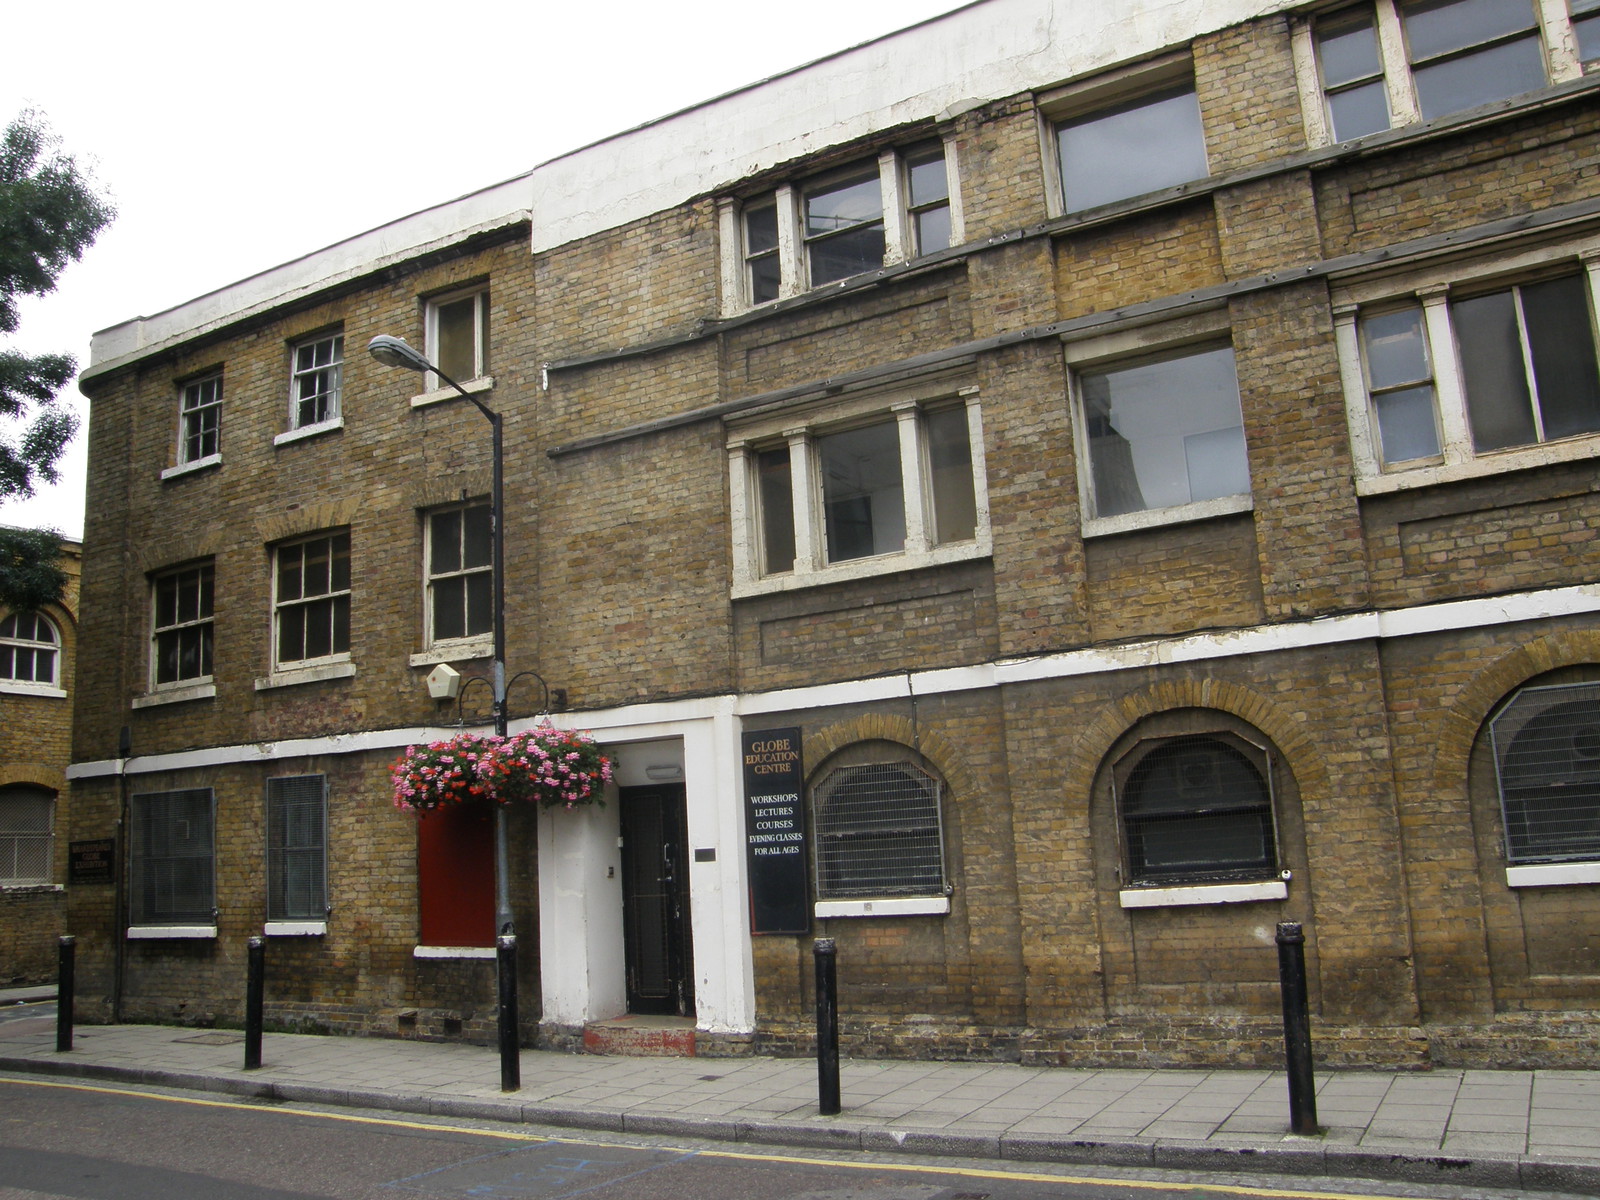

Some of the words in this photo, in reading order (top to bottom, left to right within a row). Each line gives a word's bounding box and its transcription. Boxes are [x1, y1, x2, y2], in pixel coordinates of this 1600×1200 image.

[752, 739, 790, 753] GLOBE
[746, 751, 798, 764] EDUCATION
[754, 763, 791, 774] CENTRE
[750, 793, 798, 804] WORKSHOPS
[755, 807, 793, 817] LECTURES
[756, 820, 793, 830] COURSES
[749, 834, 775, 843] EVENING
[775, 832, 803, 842] CLASSES
[754, 847, 768, 856] FOR
[768, 846, 781, 855] ALL
[782, 845, 800, 854] AGES
